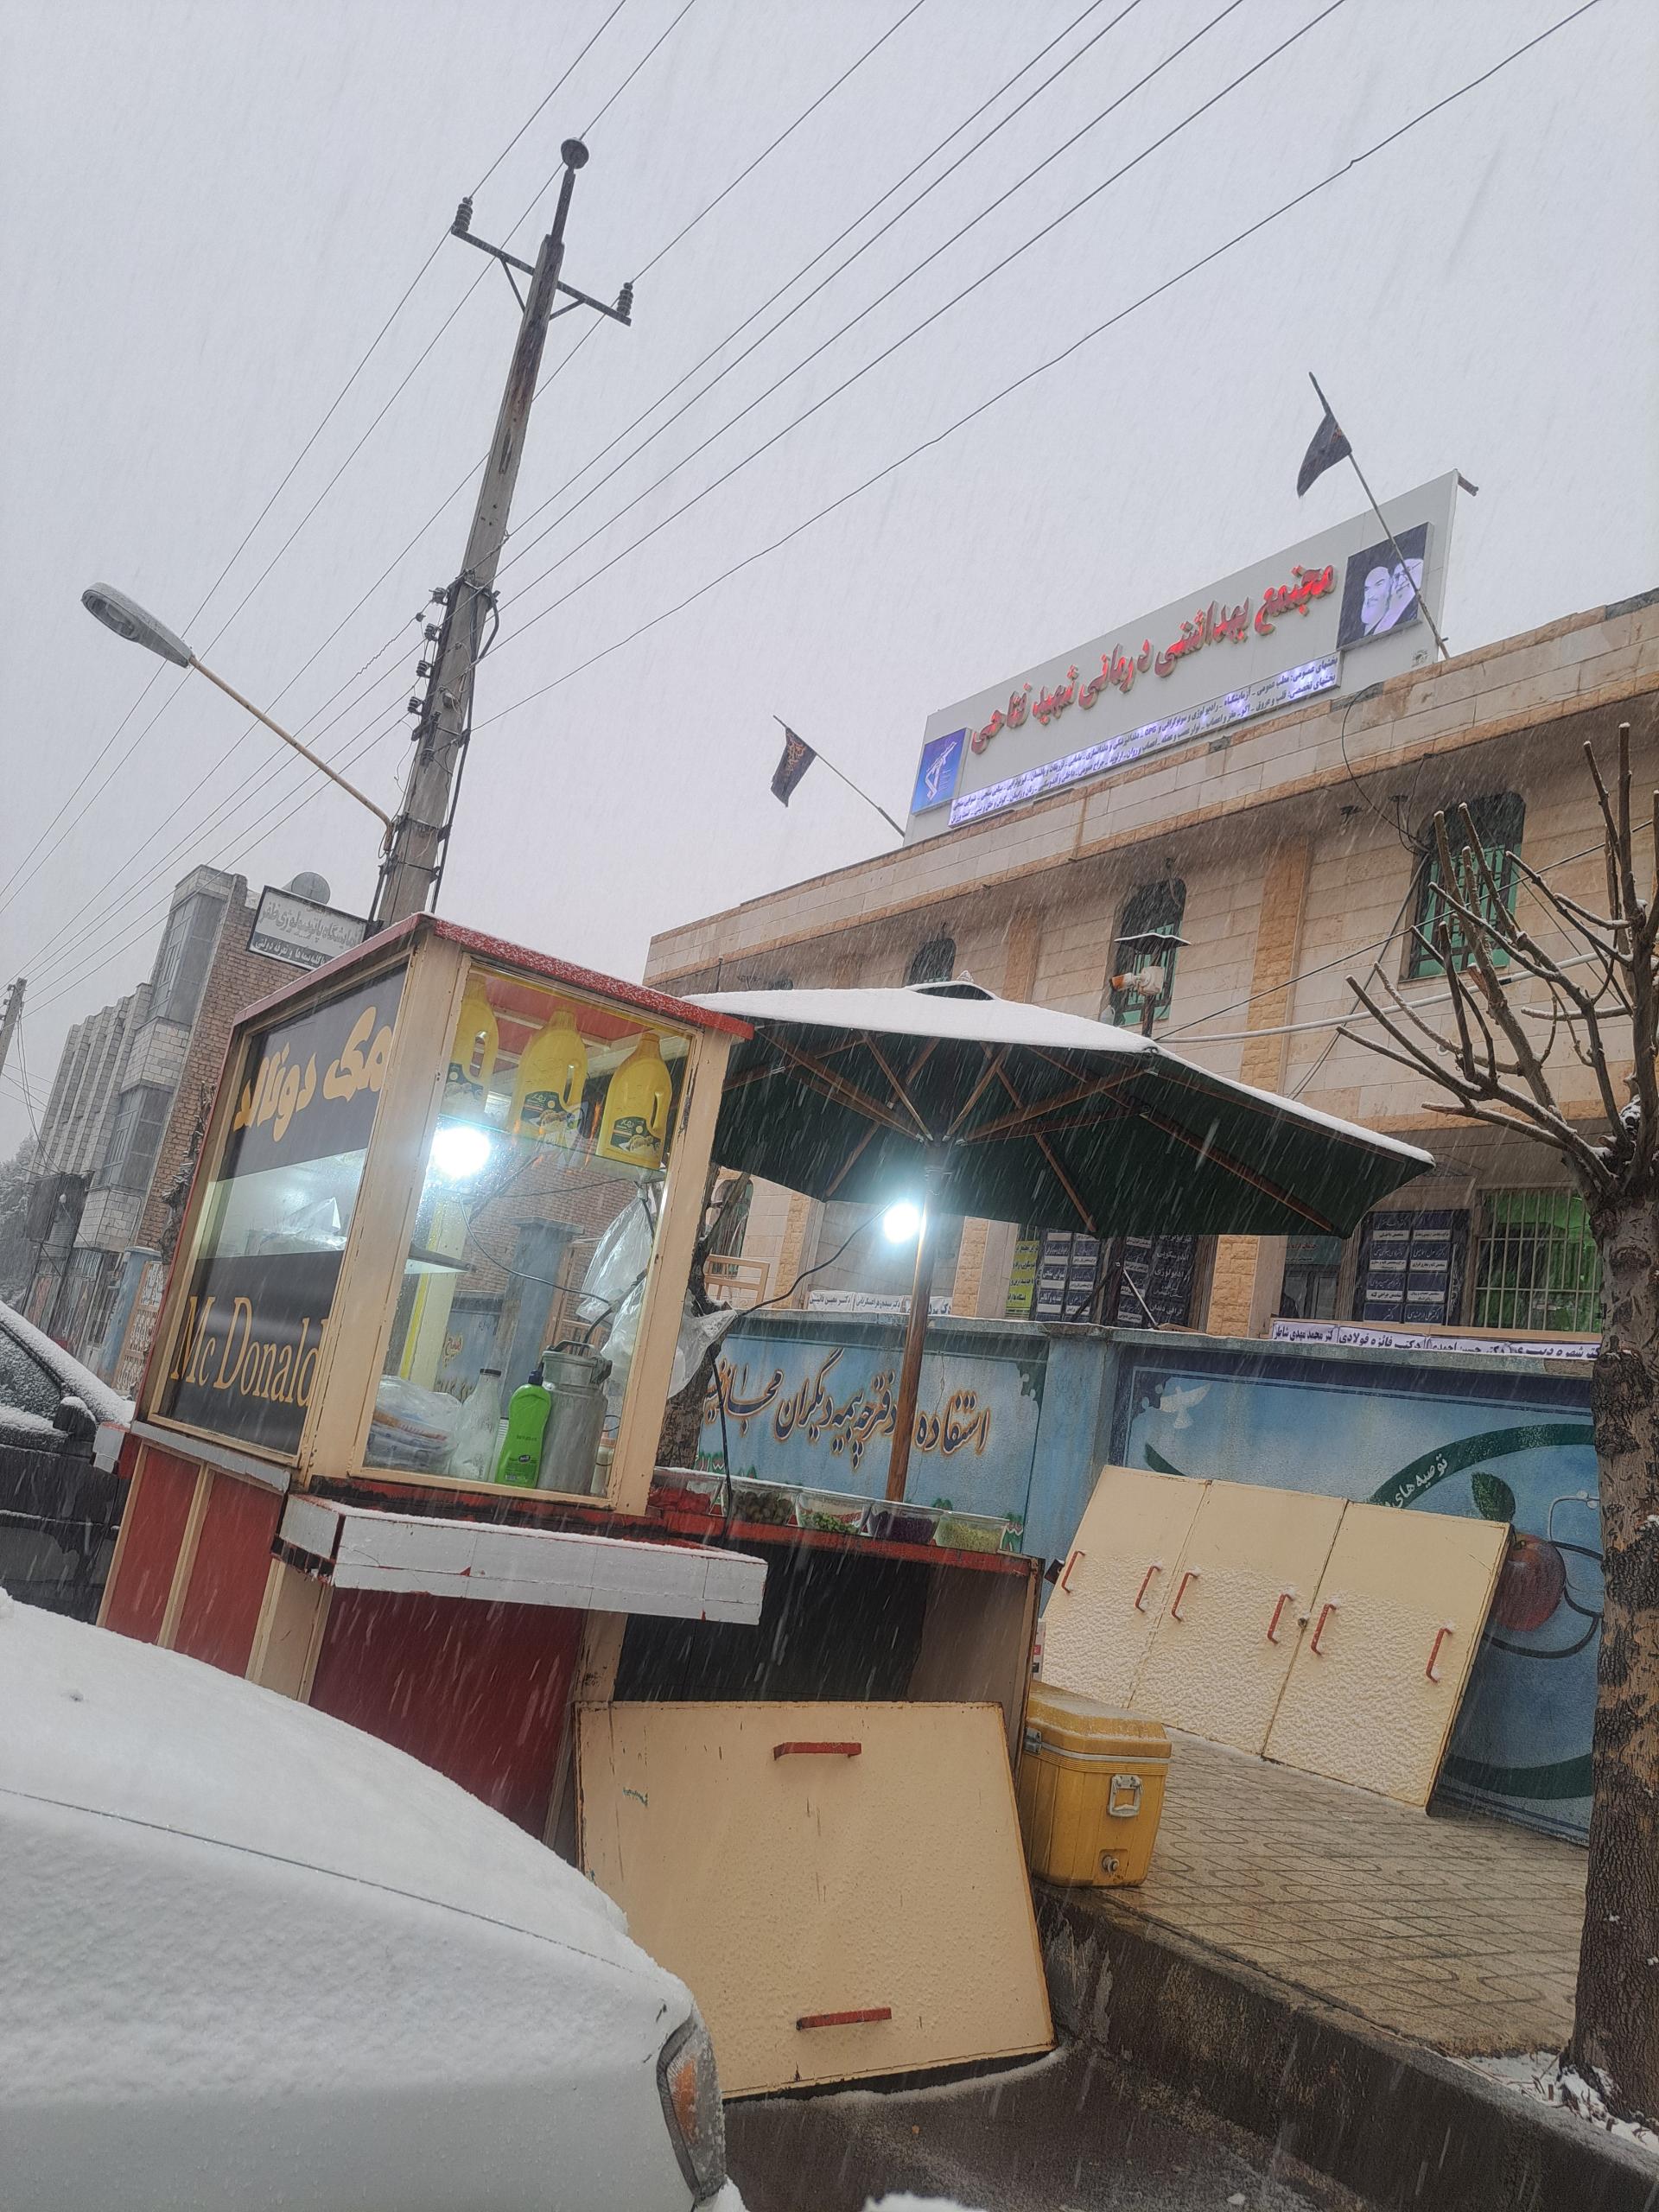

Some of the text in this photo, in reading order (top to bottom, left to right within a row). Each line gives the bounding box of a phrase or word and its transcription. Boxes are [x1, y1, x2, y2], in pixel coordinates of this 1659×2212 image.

[1255, 564, 1337, 636] مجتمع
[1154, 596, 1250, 677] بهداشتی
[1033, 664, 1079, 726] شهید
[1078, 639, 1153, 709] درمانی
[233, 1006, 393, 1142] مک دونالد
[170, 1296, 215, 1387] Mc
[1415, 1453, 1448, 1488] توصیه
